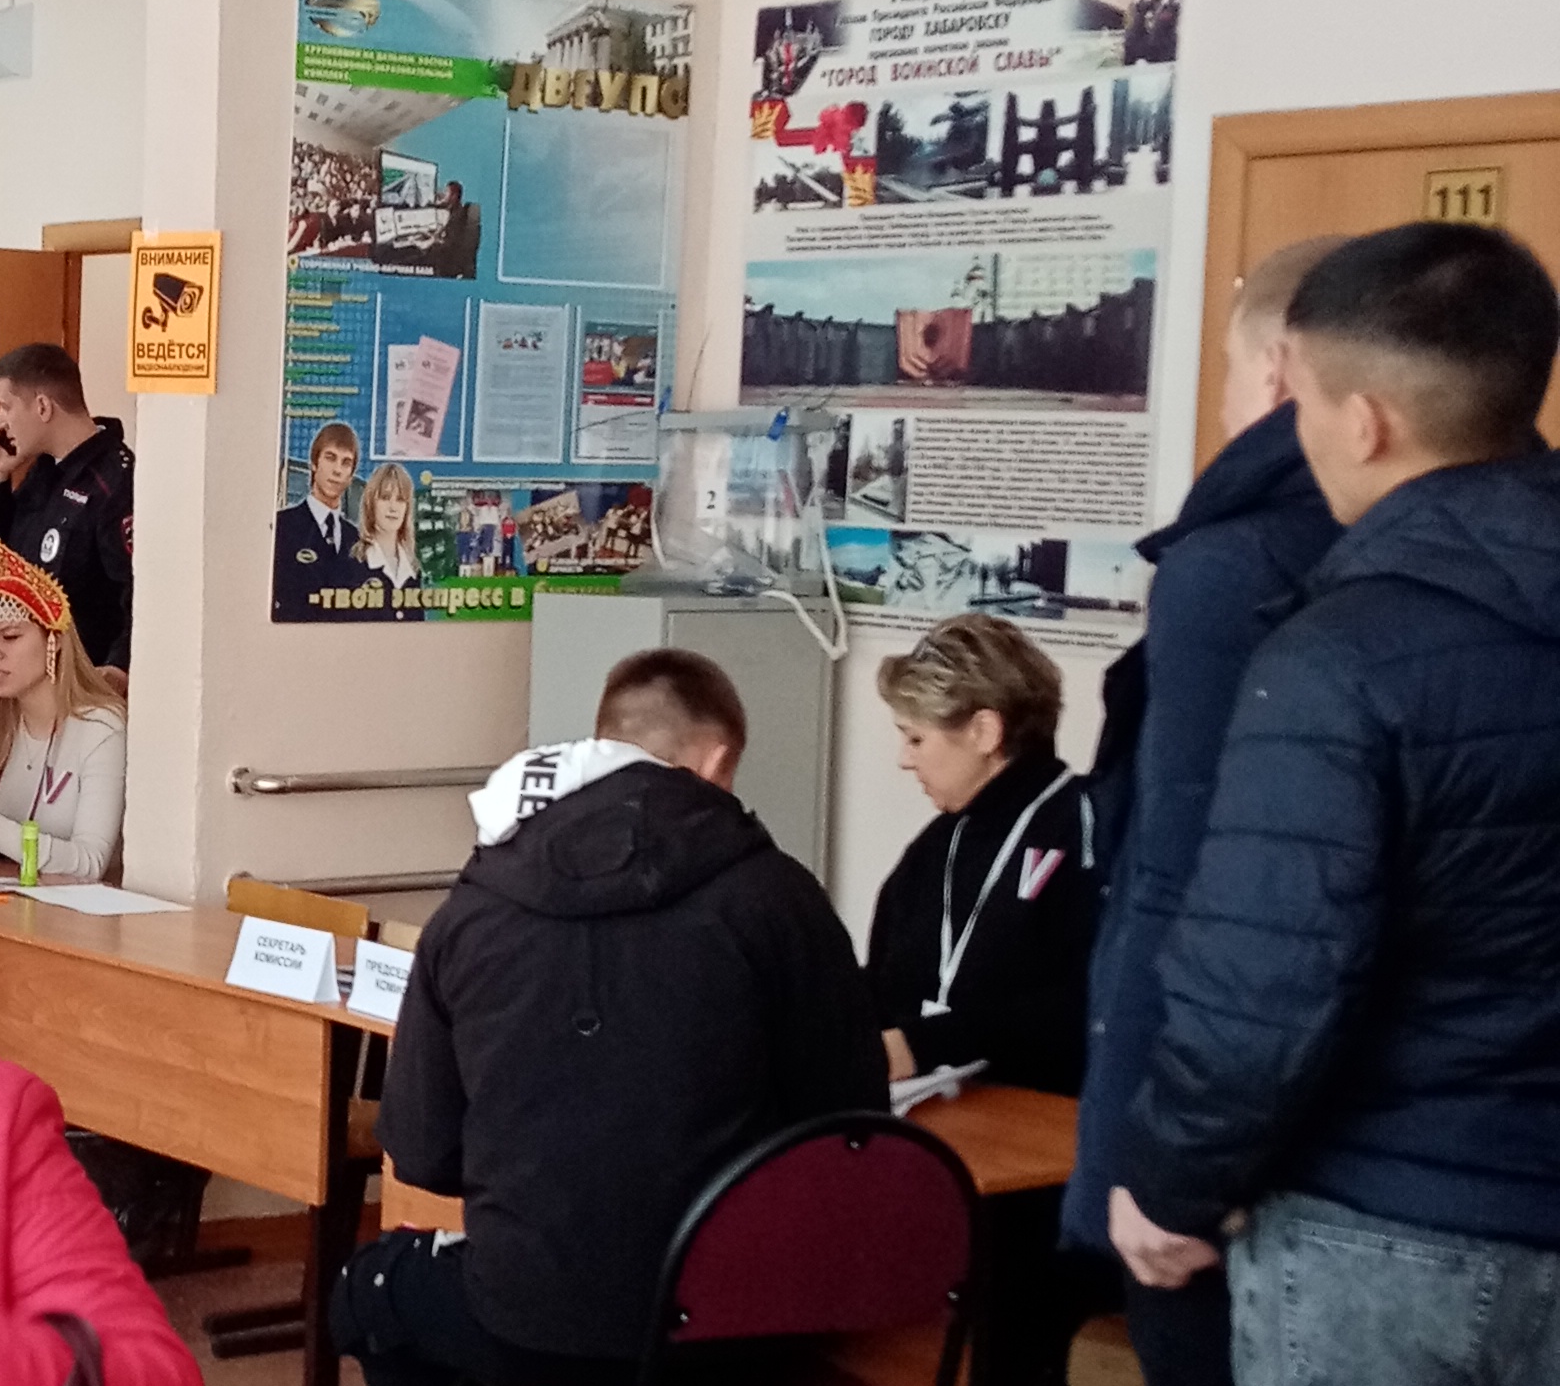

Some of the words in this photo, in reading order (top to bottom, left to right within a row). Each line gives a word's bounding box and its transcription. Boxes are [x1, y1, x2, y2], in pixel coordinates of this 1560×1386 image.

[507, 62, 690, 119] ДВГУПС
[1432, 184, 1496, 218] 111
[139, 251, 210, 266] ВНИМАНИЕ
[136, 339, 207, 363] ВЕДЁТСЯ
[136, 362, 206, 372] ВИДЕОНАБЛЮДЕНИЕ
[705, 489, 717, 510] 2
[391, 587, 505, 615] экспресс
[256, 935, 308, 955] СЕКРЕТАРЬ
[253, 950, 304, 971] КОМИССИИ
